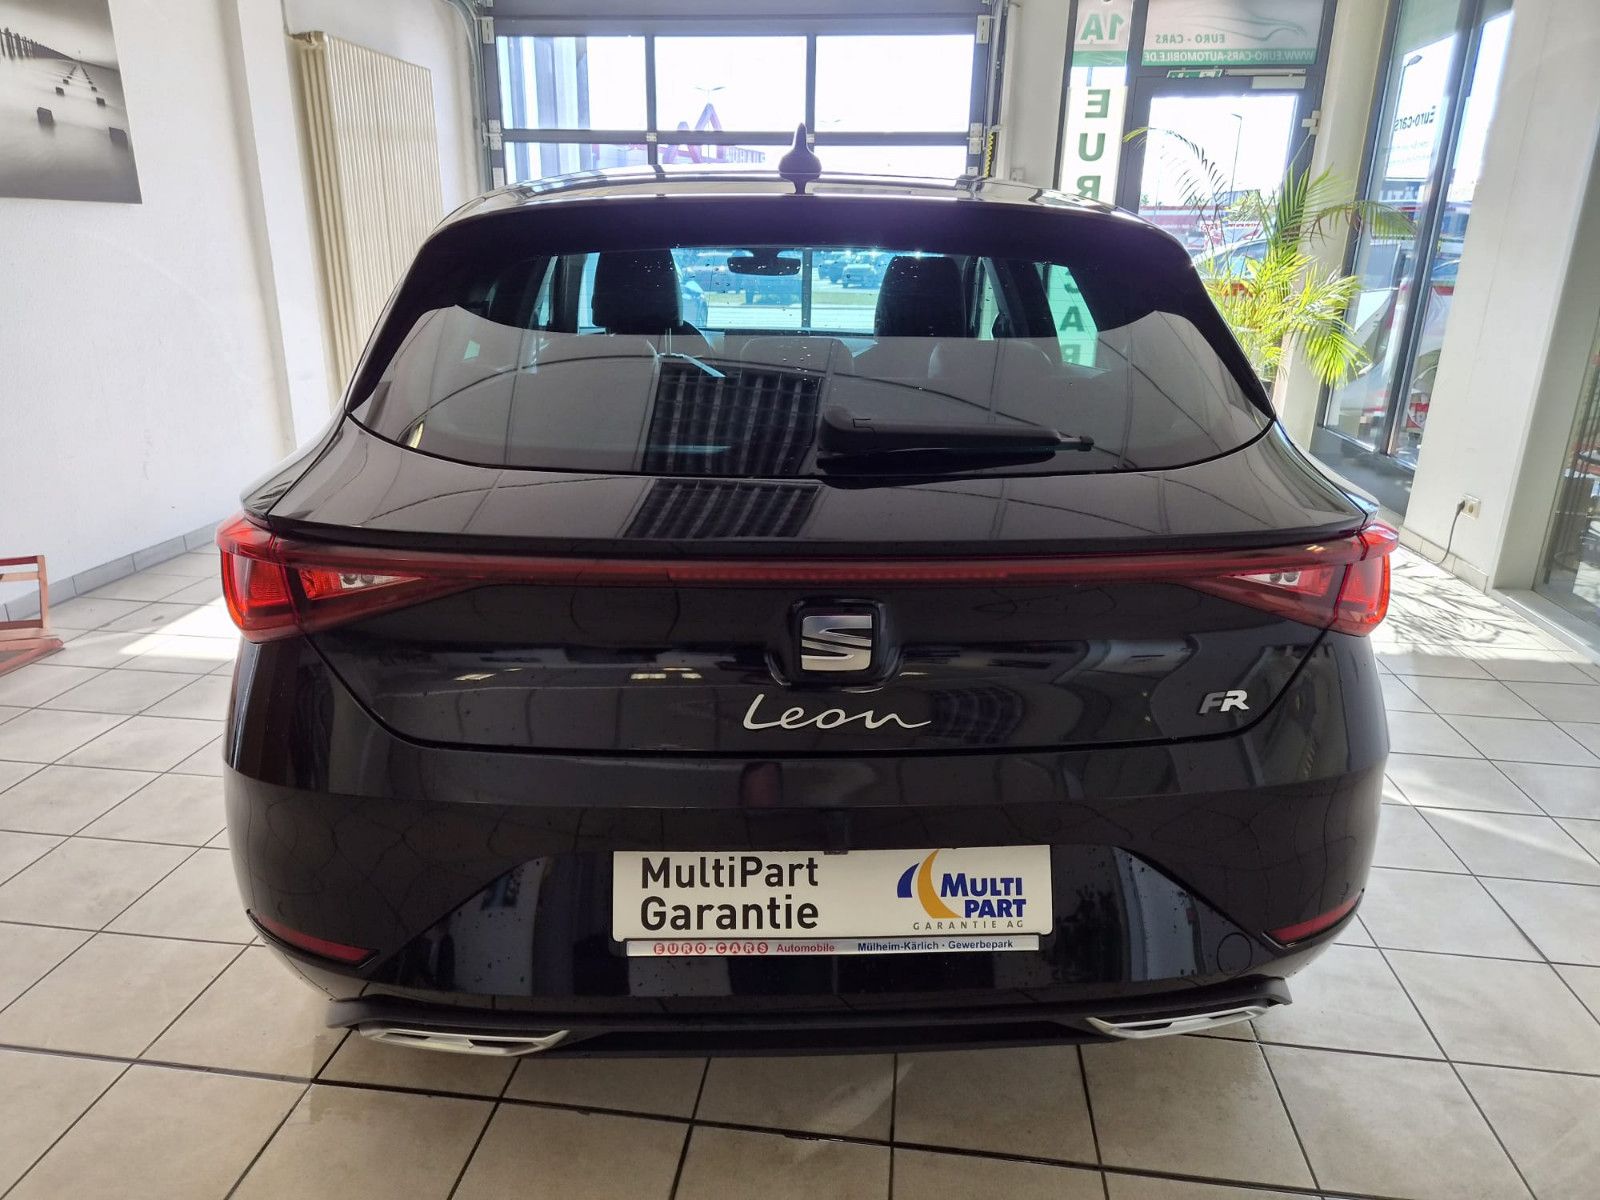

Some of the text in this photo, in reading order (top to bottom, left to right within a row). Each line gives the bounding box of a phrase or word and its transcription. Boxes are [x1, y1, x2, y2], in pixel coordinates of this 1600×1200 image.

[743, 694, 931, 730] Leon
[1199, 690, 1249, 714] FR
[641, 856, 819, 889] MultiPart
[940, 872, 1023, 897] MULTI
[640, 894, 819, 931] Garantie
[964, 898, 1027, 918] PART
[912, 919, 1024, 931] GARANTIE AG
[653, 940, 1013, 955] EURO-CARS Automobile Mülheim-Kärlich Gewerbepark
